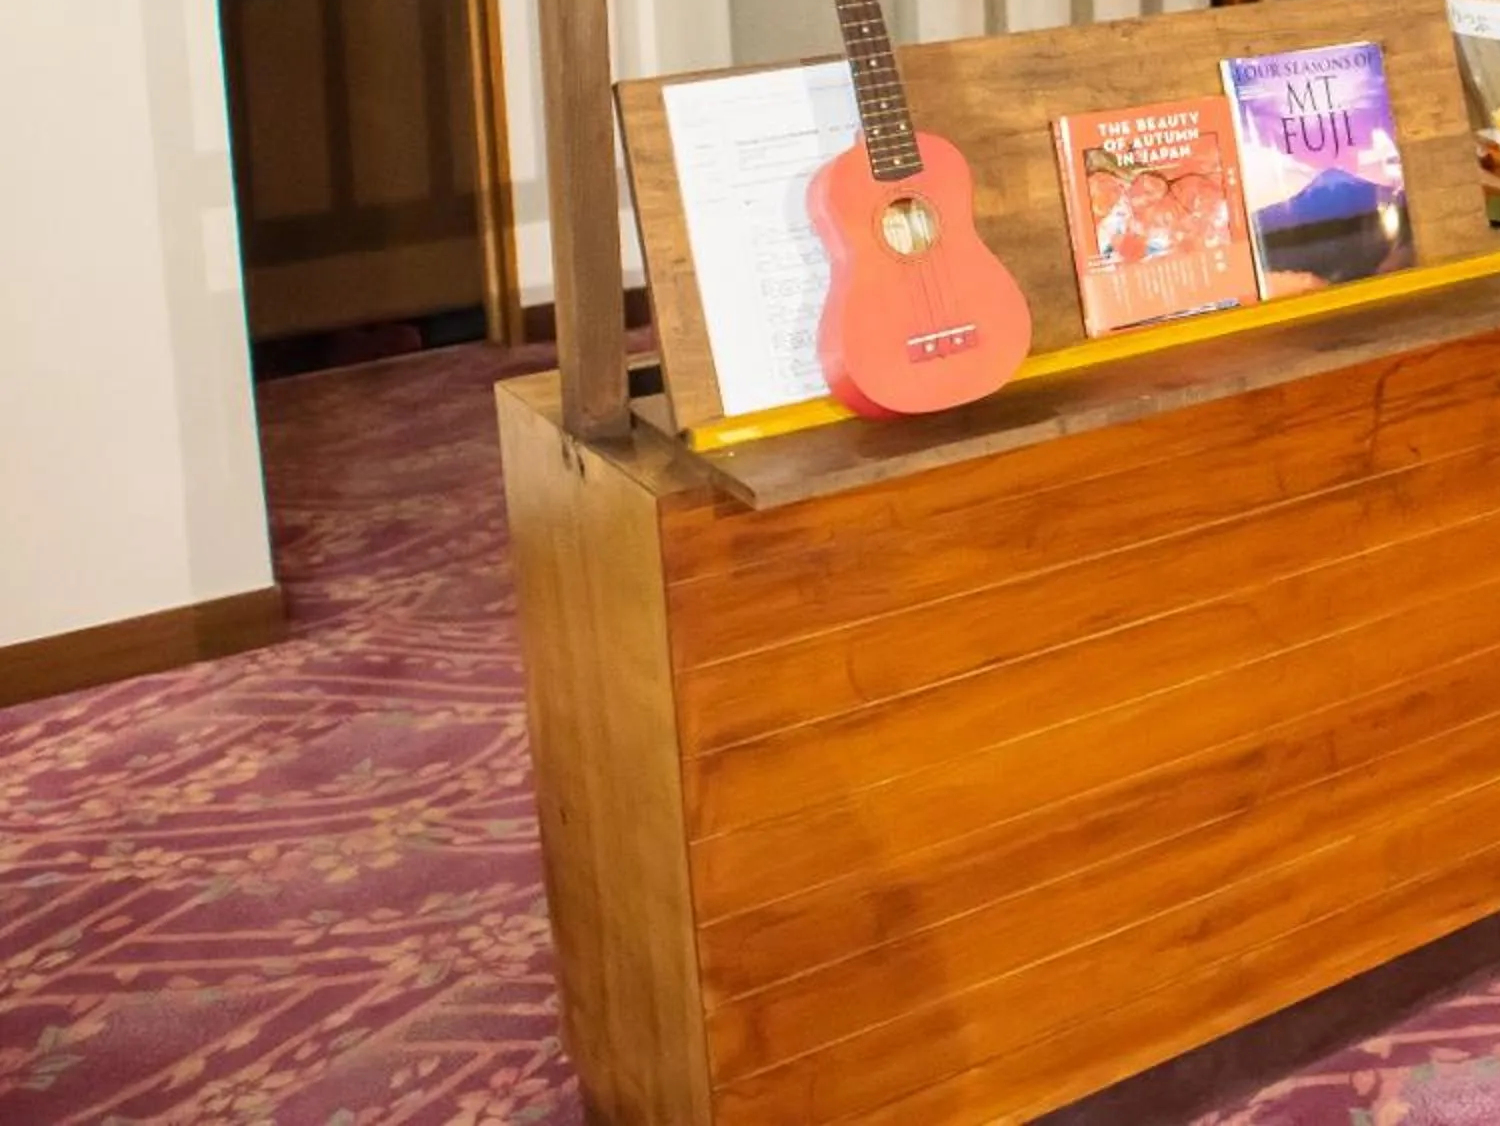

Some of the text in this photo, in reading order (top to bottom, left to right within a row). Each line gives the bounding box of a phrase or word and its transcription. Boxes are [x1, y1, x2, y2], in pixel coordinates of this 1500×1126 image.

[1097, 111, 1200, 137] THE BEAUTY
[1281, 109, 1355, 159] FUJI
[1103, 127, 1200, 152] OF AUTUMN
[1115, 144, 1192, 168] IN JAPAN
